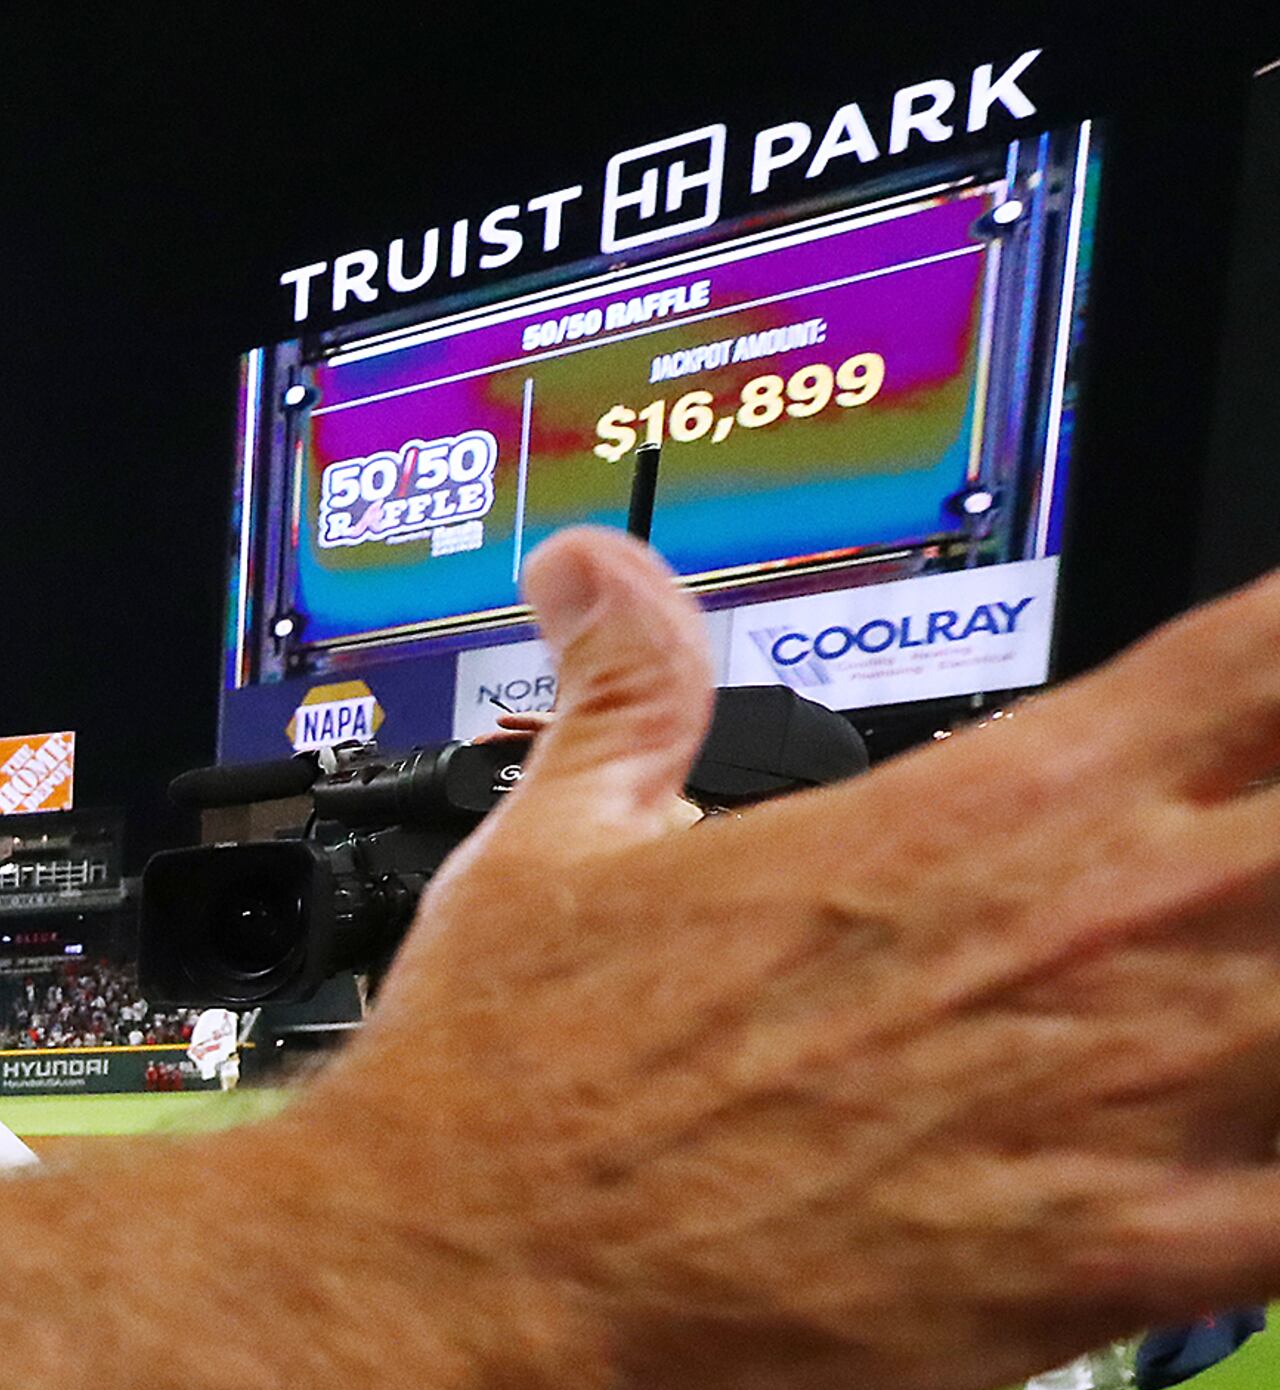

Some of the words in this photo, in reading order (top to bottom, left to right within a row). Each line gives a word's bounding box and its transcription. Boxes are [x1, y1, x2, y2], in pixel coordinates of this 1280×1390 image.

[279, 184, 583, 322] TRUIST
[750, 47, 1044, 195] PARK
[521, 308, 603, 350] 50/50
[604, 278, 712, 331] RAFFLE
[648, 339, 734, 384] JACKPOT
[731, 317, 828, 363] AMOUNT:
[593, 351, 886, 463] $16,899
[327, 437, 490, 509] 50/50
[770, 595, 1036, 666] COOLRAY
[302, 703, 368, 743] NAPA
[0, 743, 35, 777] THE
[2, 1058, 109, 1078] HYUNDAI
